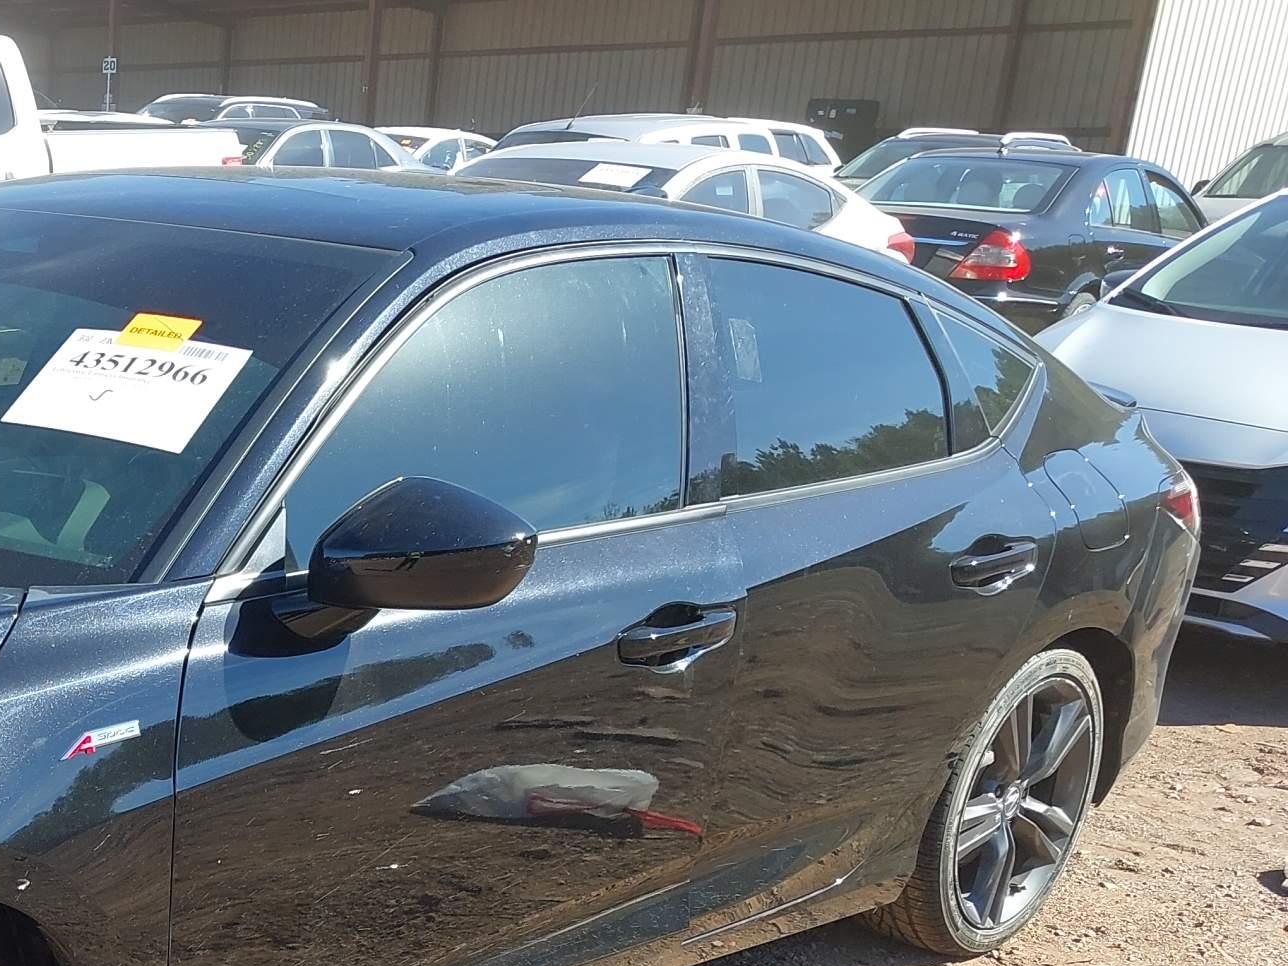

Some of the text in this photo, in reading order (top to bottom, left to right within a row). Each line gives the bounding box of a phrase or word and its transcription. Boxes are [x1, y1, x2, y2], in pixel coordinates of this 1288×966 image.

[103, 60, 116, 71] 20
[129, 327, 183, 339] DETAILER
[69, 350, 212, 386] 43512966
